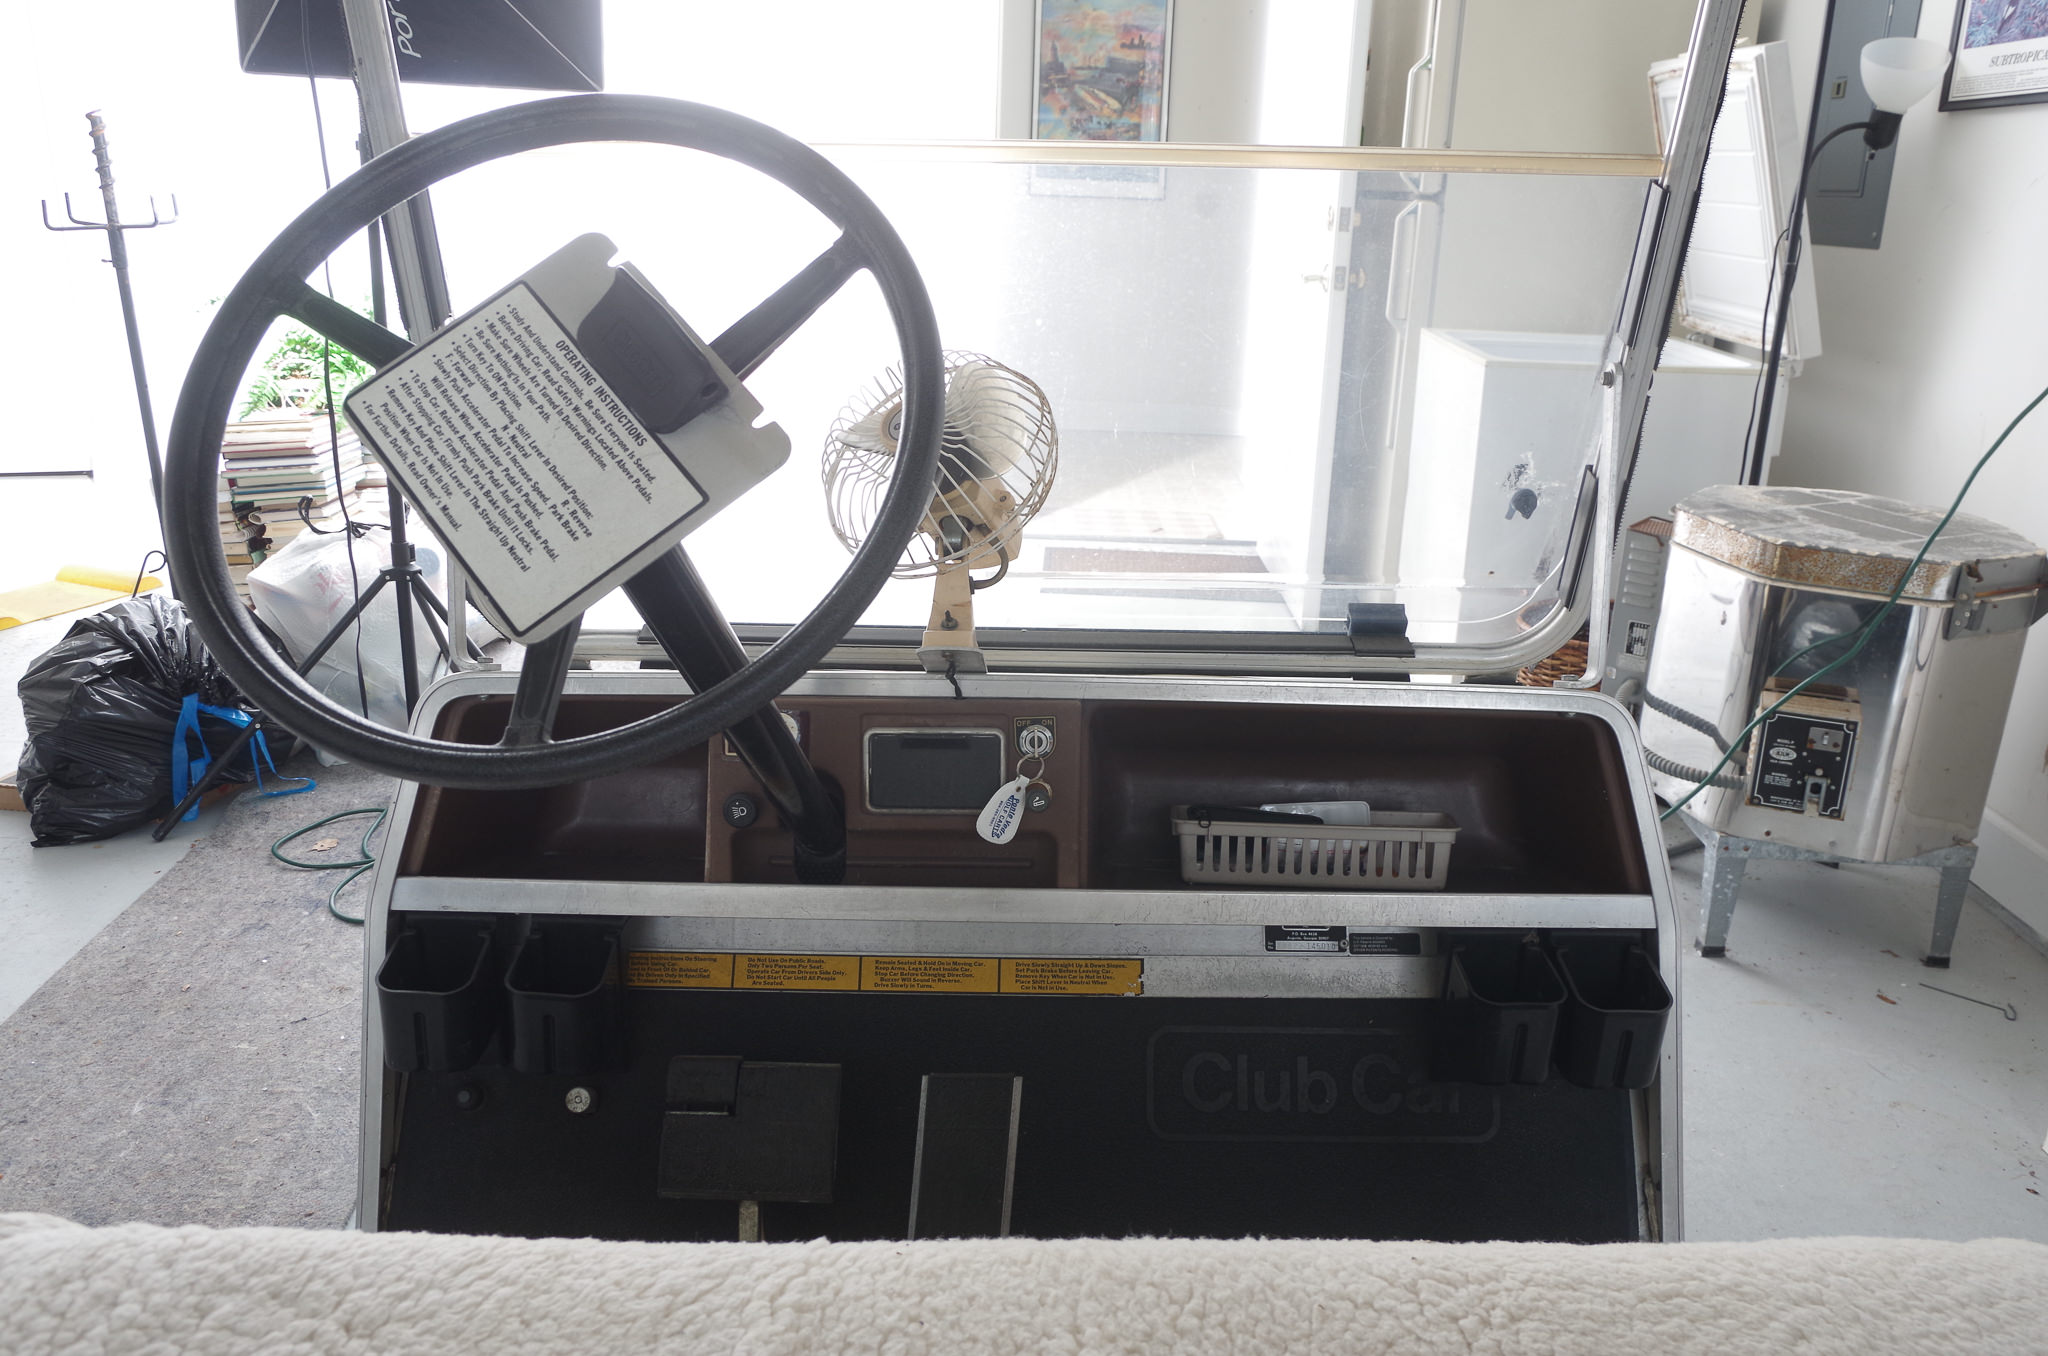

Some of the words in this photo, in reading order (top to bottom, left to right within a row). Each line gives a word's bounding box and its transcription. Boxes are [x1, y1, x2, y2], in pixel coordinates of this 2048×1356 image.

[387, 0, 422, 58] por
[399, 381, 415, 399] After
[451, 361, 475, 388] Forward
[464, 337, 479, 354] Turn
[474, 350, 488, 365] Key
[484, 362, 494, 374] To
[491, 371, 504, 383] ON
[498, 380, 522, 411] Position.
[475, 329, 485, 340] Be
[482, 338, 496, 354] Sure
[493, 351, 517, 379] Nothing
[511, 374, 520, 385] Is
[516, 381, 526, 392] In
[523, 388, 538, 406] Your
[534, 403, 551, 424] Path.
[486, 321, 502, 340] Make
[499, 338, 514, 355] Sure
[511, 351, 532, 377] Wheels
[527, 374, 541, 388] Are
[538, 385, 561, 411] Turned
[555, 407, 565, 417] In
[560, 414, 586, 441] Desired
[580, 438, 607, 471] Direction.
[508, 307, 525, 326] Study
[522, 324, 537, 339] And
[532, 335, 565, 372] Understand
[559, 369, 584, 400] Controls.
[583, 398, 594, 410] Be
[591, 407, 607, 425] Sure
[603, 422, 630, 453] Everyone
[626, 450, 636, 460] Is
[632, 457, 656, 484] Seated.
[555, 339, 597, 387] OPERATING
[592, 385, 648, 447] INSTRUCTIONS
[411, 397, 436, 427] Stopping
[432, 424, 445, 441] Car,
[452, 344, 472, 366] Select
[467, 362, 492, 393] Direction
[488, 390, 499, 402] By
[495, 399, 518, 425] Placing
[514, 423, 532, 441] Shift
[527, 439, 546, 459] Lever
[541, 457, 551, 467] In
[547, 464, 573, 492] Desired
[566, 488, 594, 520] Position:
[497, 314, 516, 336] Before
[513, 333, 534, 359] Driving
[530, 355, 543, 372] Car,
[540, 368, 559, 387] Read
[554, 384, 574, 407] Safety
[571, 403, 597, 436] Warnings
[594, 432, 620, 460] Located
[614, 458, 634, 480] Above
[631, 477, 652, 504] Pedals.
[363, 403, 375, 416] For
[371, 414, 392, 439] Further
[388, 437, 409, 464] Details,
[406, 461, 425, 480] Read
[419, 477, 442, 506] Owner's
[439, 503, 462, 532] Manual.
[379, 401, 402, 429] Position
[398, 426, 415, 447] When
[411, 444, 424, 458] Car
[420, 455, 429, 466] Is
[425, 462, 439, 478] Not
[434, 474, 444, 485] In
[440, 481, 453, 499] Use.
[411, 373, 420, 384] To
[417, 381, 431, 399] Stop
[428, 396, 440, 412] Car,
[438, 409, 460, 436] Release
[456, 433, 488, 471] Accelerator
[484, 469, 505, 490] Pedal
[499, 488, 515, 504] And
[510, 502, 528, 522] Push
[523, 518, 543, 541] Brake
[539, 538, 560, 563] Pedal.
[430, 375, 445, 390] Will
[439, 387, 461, 414] Release
[458, 411, 475, 432] When
[471, 430, 504, 468] Accelerator
[500, 466, 521, 488] Pedal
[514, 484, 524, 494] Is
[520, 491, 544, 520] Pushed.
[433, 358, 452, 380] Slowly
[448, 377, 464, 395] Push
[460, 393, 491, 429] Accelerator
[487, 427, 507, 448] Pedal
[502, 444, 512, 457] To
[508, 453, 533, 483] Increase
[529, 480, 551, 506] Speed.
[547, 503, 565, 522] Park
[560, 519, 579, 542] Brake
[442, 437, 462, 460] Firmly
[457, 457, 475, 476] Push
[500, 423, 510, 432] N
[508, 433, 532, 459] Neutral
[386, 388, 407, 414] Remove
[404, 411, 417, 427] Key
[413, 424, 429, 439] And
[423, 436, 440, 456] Place
[436, 454, 453, 473] Shift
[448, 469, 466, 490] Lever
[462, 487, 472, 498] In
[468, 494, 481, 511] The
[477, 508, 503, 538] Straight
[498, 534, 510, 547] Up
[506, 544, 531, 573] Neutral
[470, 473, 486, 492] Park
[482, 488, 501, 511] Brake
[497, 507, 516, 527] Until
[509, 524, 520, 534] It
[514, 530, 533, 556] Locks.
[560, 498, 570, 508] R
[568, 508, 593, 538] Reverse
[1181, 1051, 1340, 1115] Club
